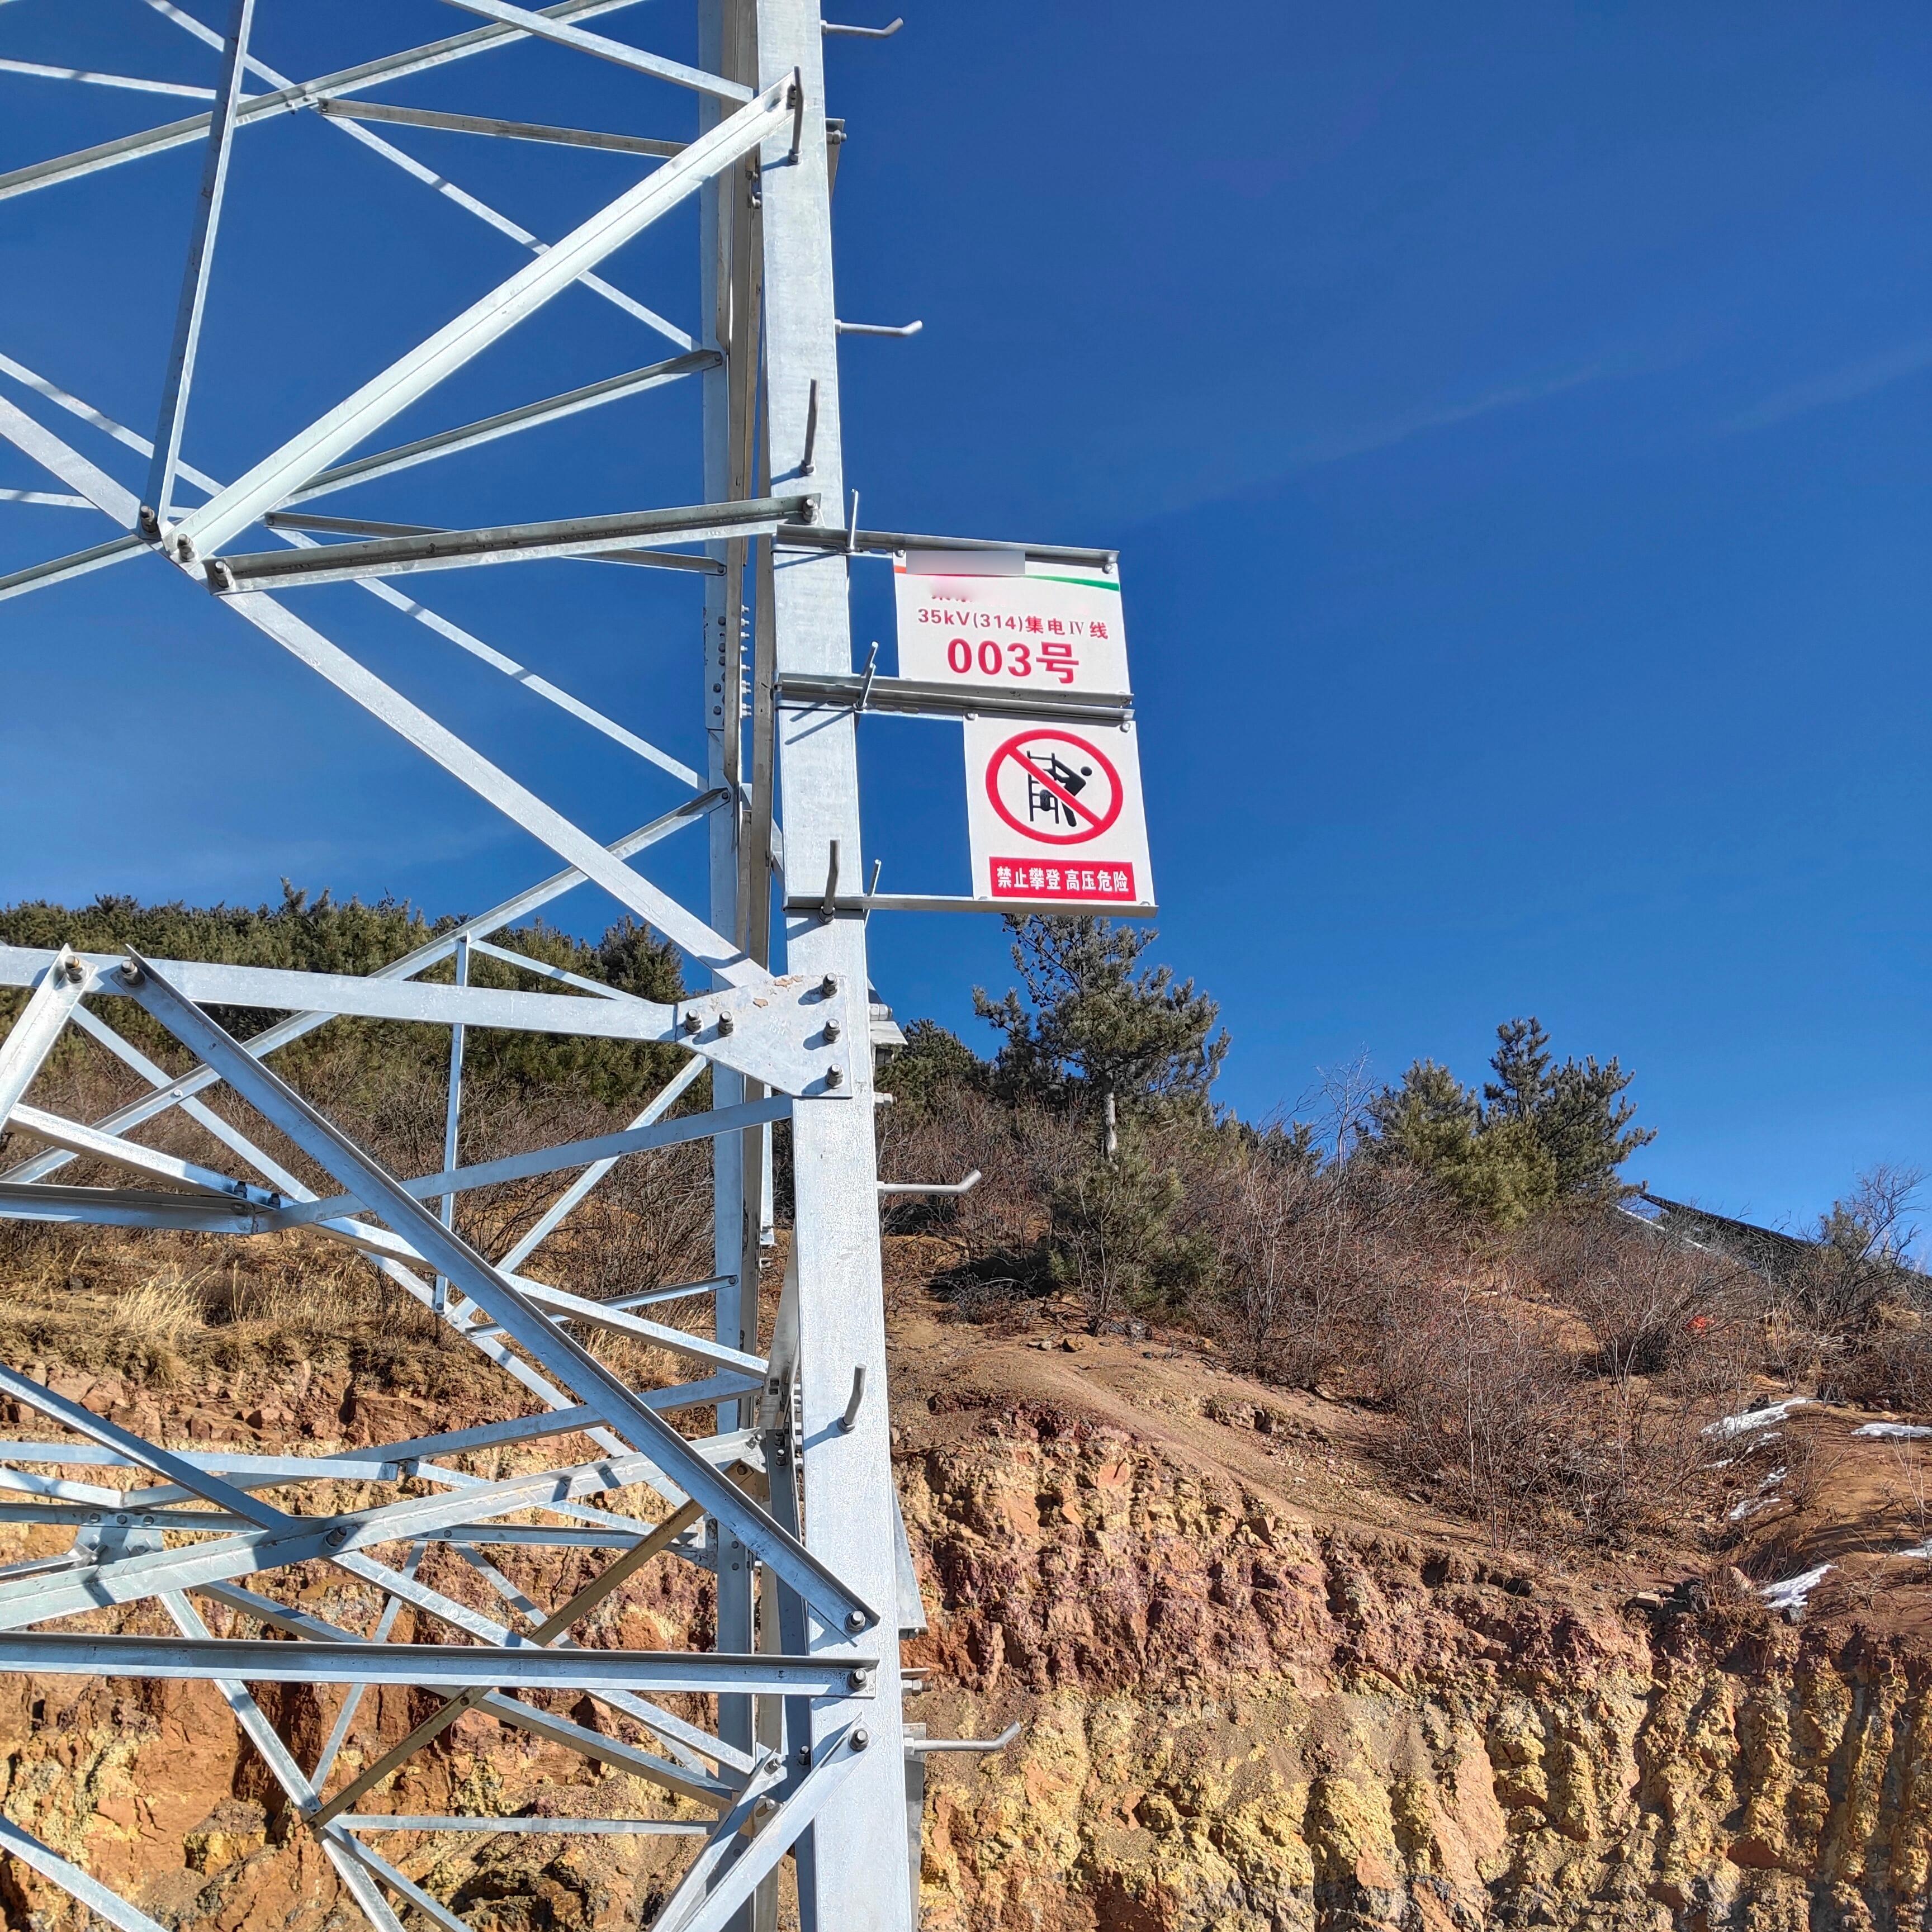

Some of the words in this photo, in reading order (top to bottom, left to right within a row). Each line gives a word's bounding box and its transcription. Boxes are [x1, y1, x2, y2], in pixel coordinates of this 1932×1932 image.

[948, 638, 1079, 684] 003号
[997, 866, 1061, 890] 禁止攀登
[1064, 869, 1129, 892] 高压危险
